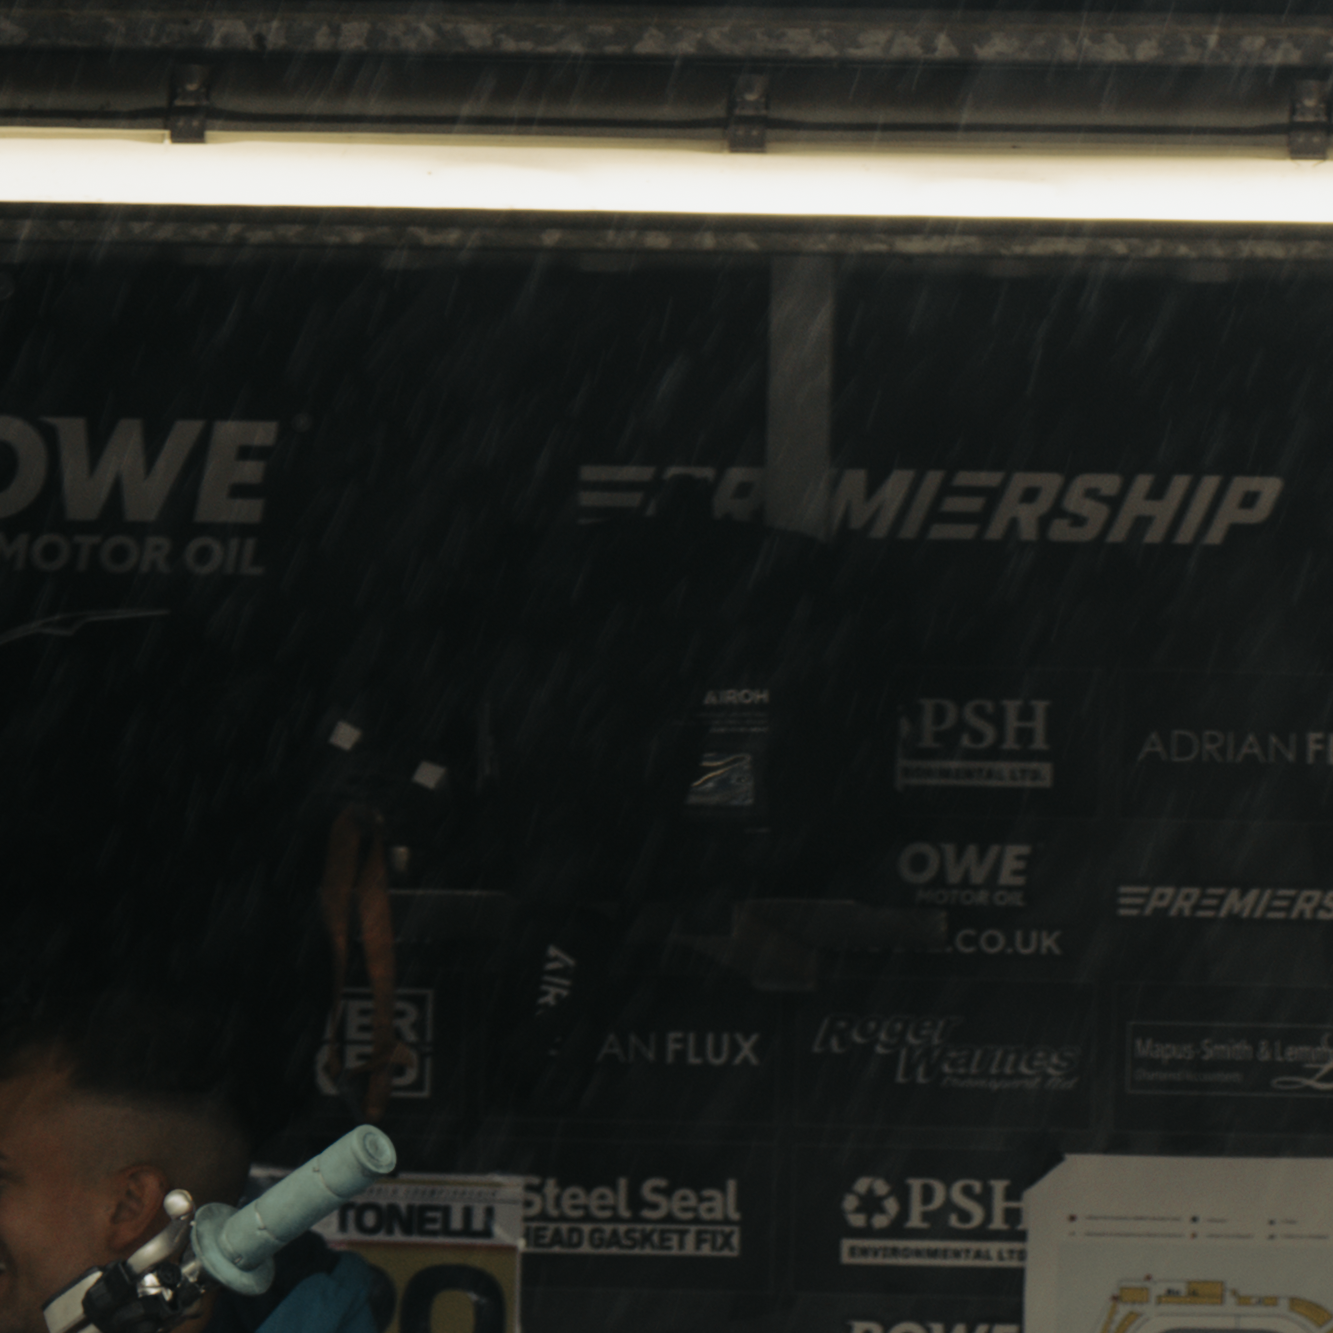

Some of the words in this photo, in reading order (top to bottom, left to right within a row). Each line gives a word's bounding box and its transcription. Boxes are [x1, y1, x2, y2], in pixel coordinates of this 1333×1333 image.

[185, 536, 266, 576] OIL
[915, 698, 1051, 752] PSH
[1138, 729, 1297, 764] ADRIAN
[664, 1031, 761, 1065] FLUX
[1253, 1040, 1270, 1062] &
[521, 1175, 630, 1220] Steel
[641, 1177, 741, 1223] Seal
[589, 1228, 688, 1252] GASKET
[694, 1230, 736, 1253] FIX
